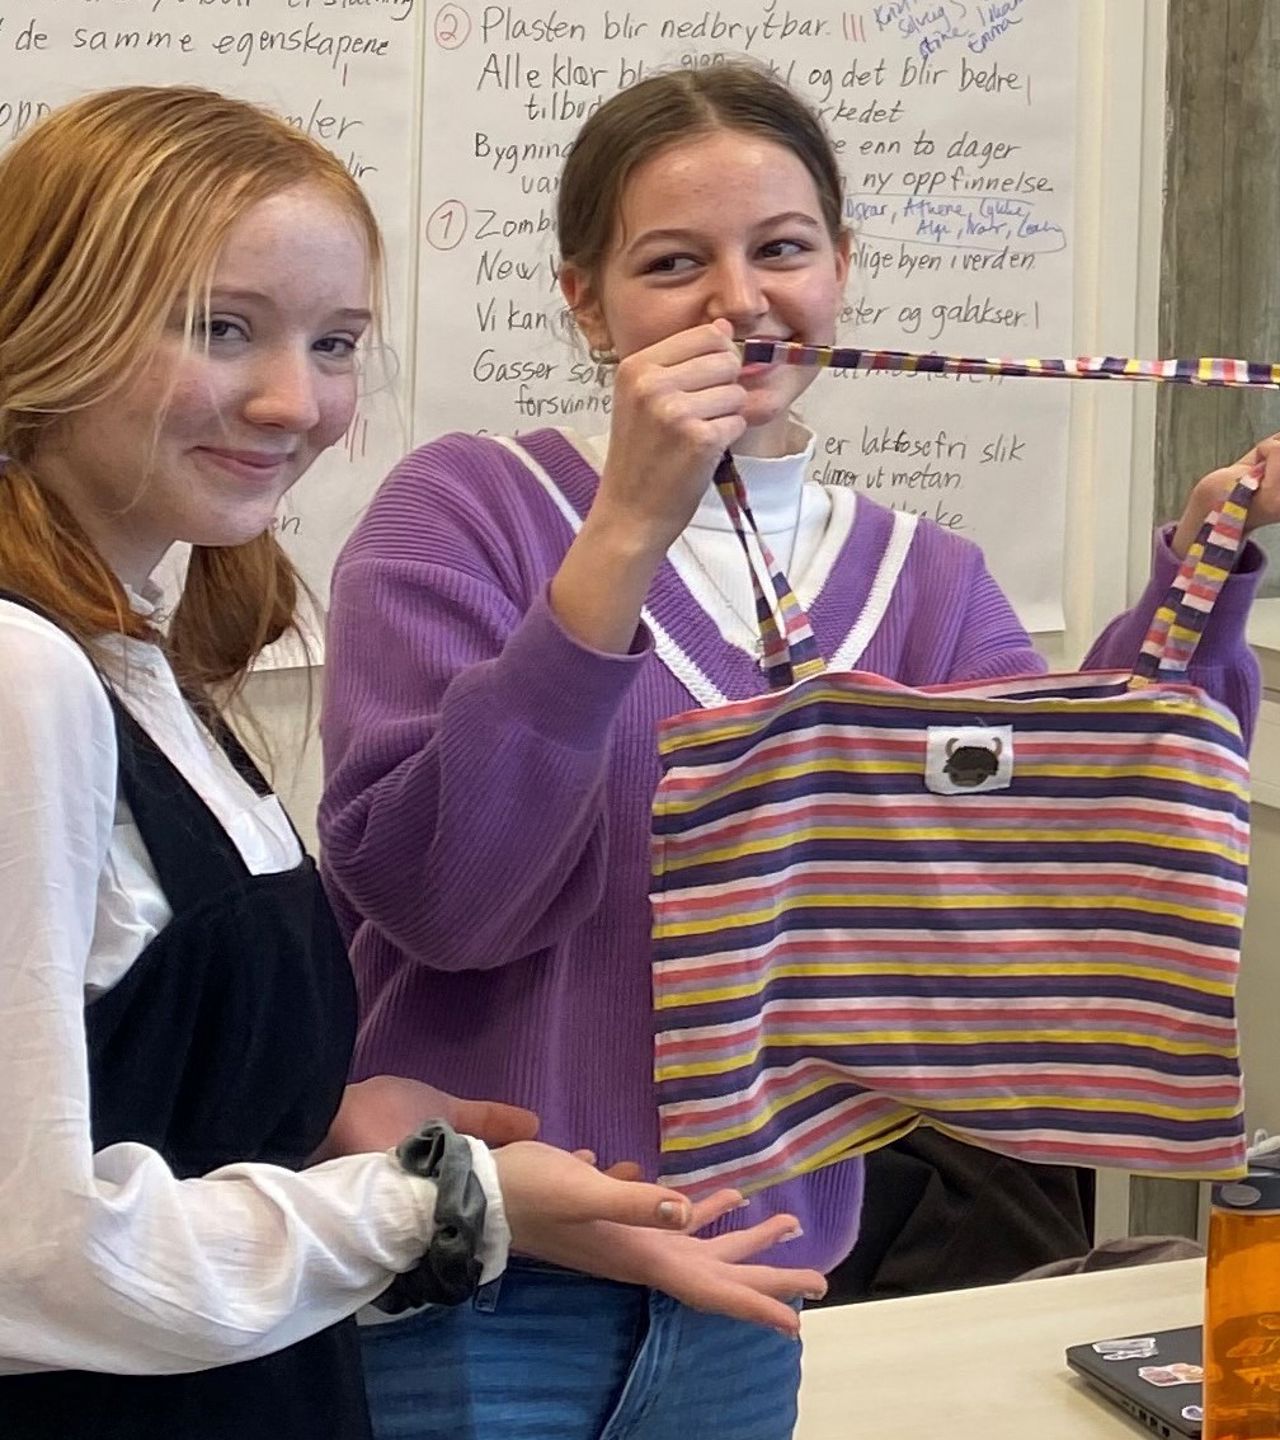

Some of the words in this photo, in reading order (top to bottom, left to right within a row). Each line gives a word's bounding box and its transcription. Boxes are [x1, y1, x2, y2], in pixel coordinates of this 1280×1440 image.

[15, 18, 48, 50] de
[73, 28, 196, 51] samme
[213, 21, 390, 66] egenskapene
[480, 6, 586, 44] Plasten
[604, 11, 649, 40] blir
[477, 53, 542, 90] Alle
[551, 57, 609, 89] klær
[808, 68, 833, 103] og
[841, 58, 888, 89] det
[899, 56, 949, 88] blir
[958, 57, 1022, 93] bedre
[859, 140, 901, 155] enn
[913, 129, 936, 155] to
[947, 131, 1022, 168] dager
[863, 172, 894, 195] ny
[902, 166, 1054, 197] oppfinnelse
[476, 249, 540, 285] New
[898, 242, 942, 278] byen
[476, 297, 495, 331] Vi
[508, 299, 547, 331] kan
[898, 304, 923, 334] og
[473, 348, 559, 383] Gasser
[825, 435, 850, 456] er
[979, 433, 1027, 464] slik
[866, 466, 884, 489] ut
